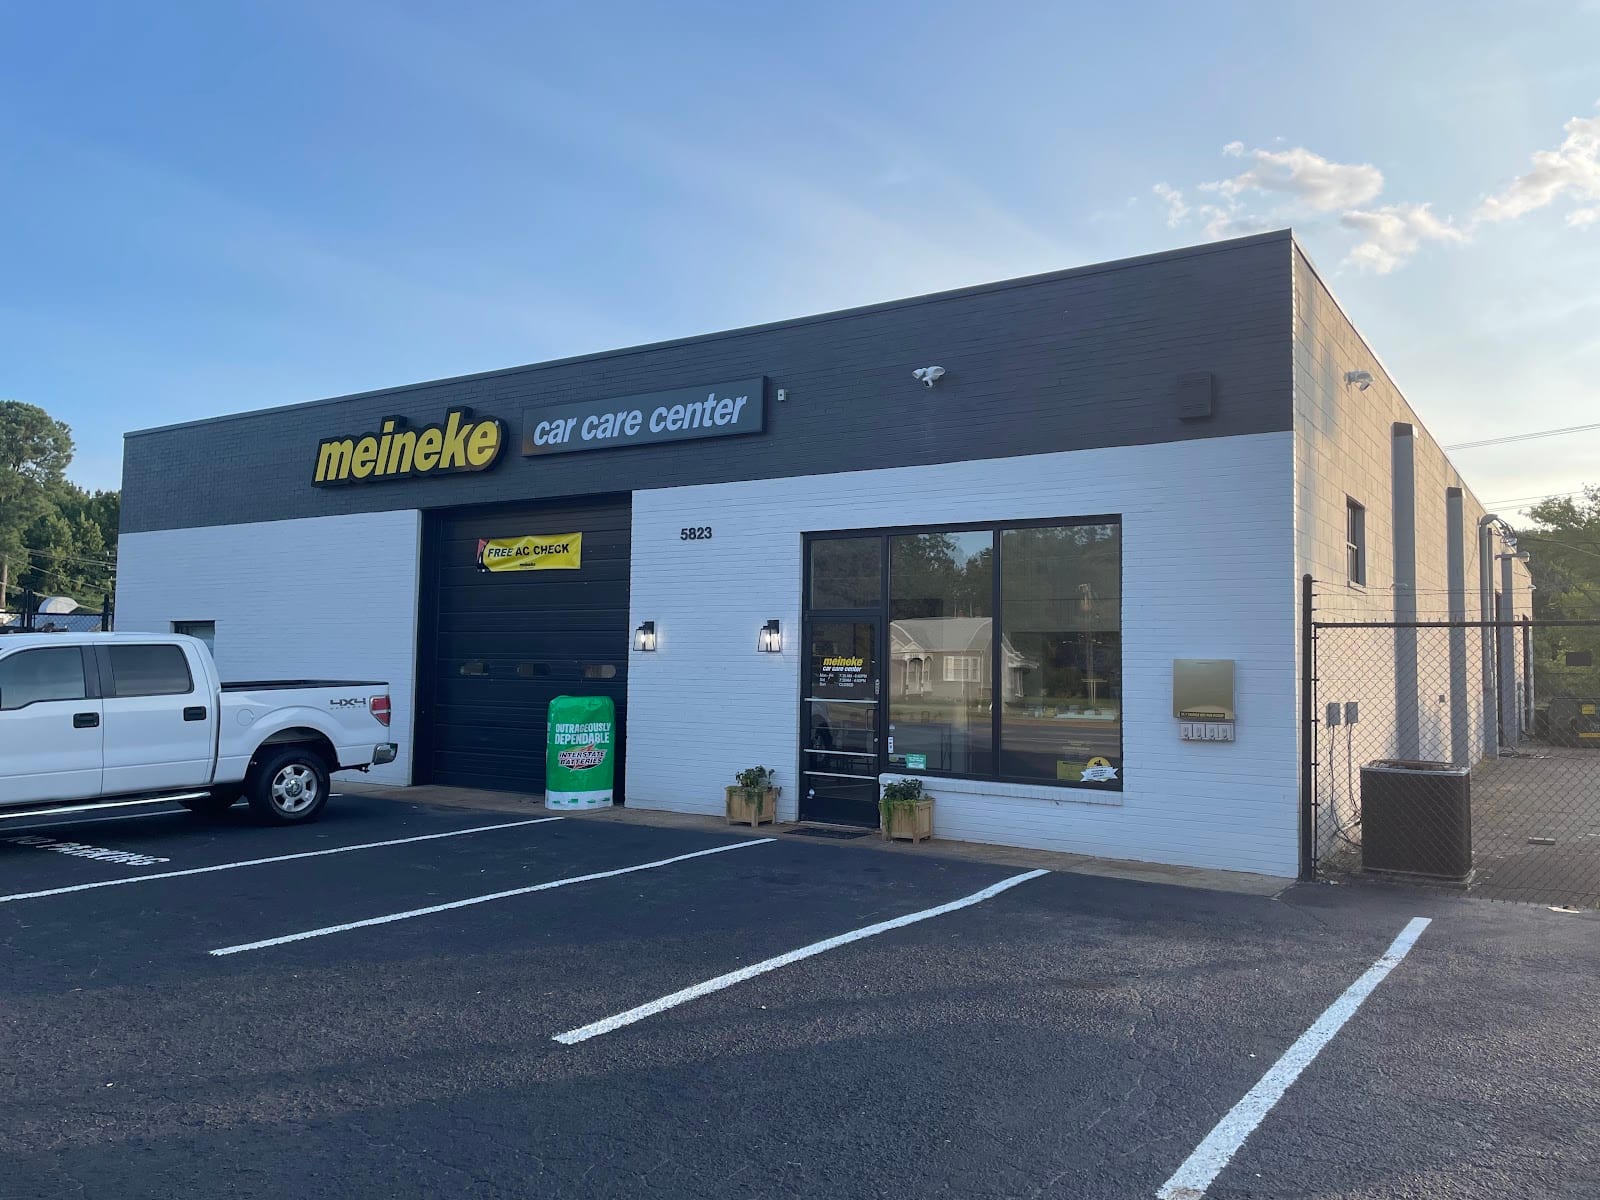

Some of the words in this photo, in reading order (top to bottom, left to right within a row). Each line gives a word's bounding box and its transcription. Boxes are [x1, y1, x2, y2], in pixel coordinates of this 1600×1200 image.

[533, 416, 577, 446] car
[580, 409, 643, 441] care
[649, 392, 748, 434] center
[314, 411, 500, 483] meineke
[680, 526, 712, 541] 5823
[487, 547, 513, 558] FREE
[515, 546, 530, 557] AC
[533, 543, 570, 555] CHECK
[823, 656, 863, 666] meineke
[556, 723, 611, 733] OUTRAGEOUSLY
[555, 733, 610, 744] DEPENDABLE
[560, 758, 602, 766] BATTERIES
